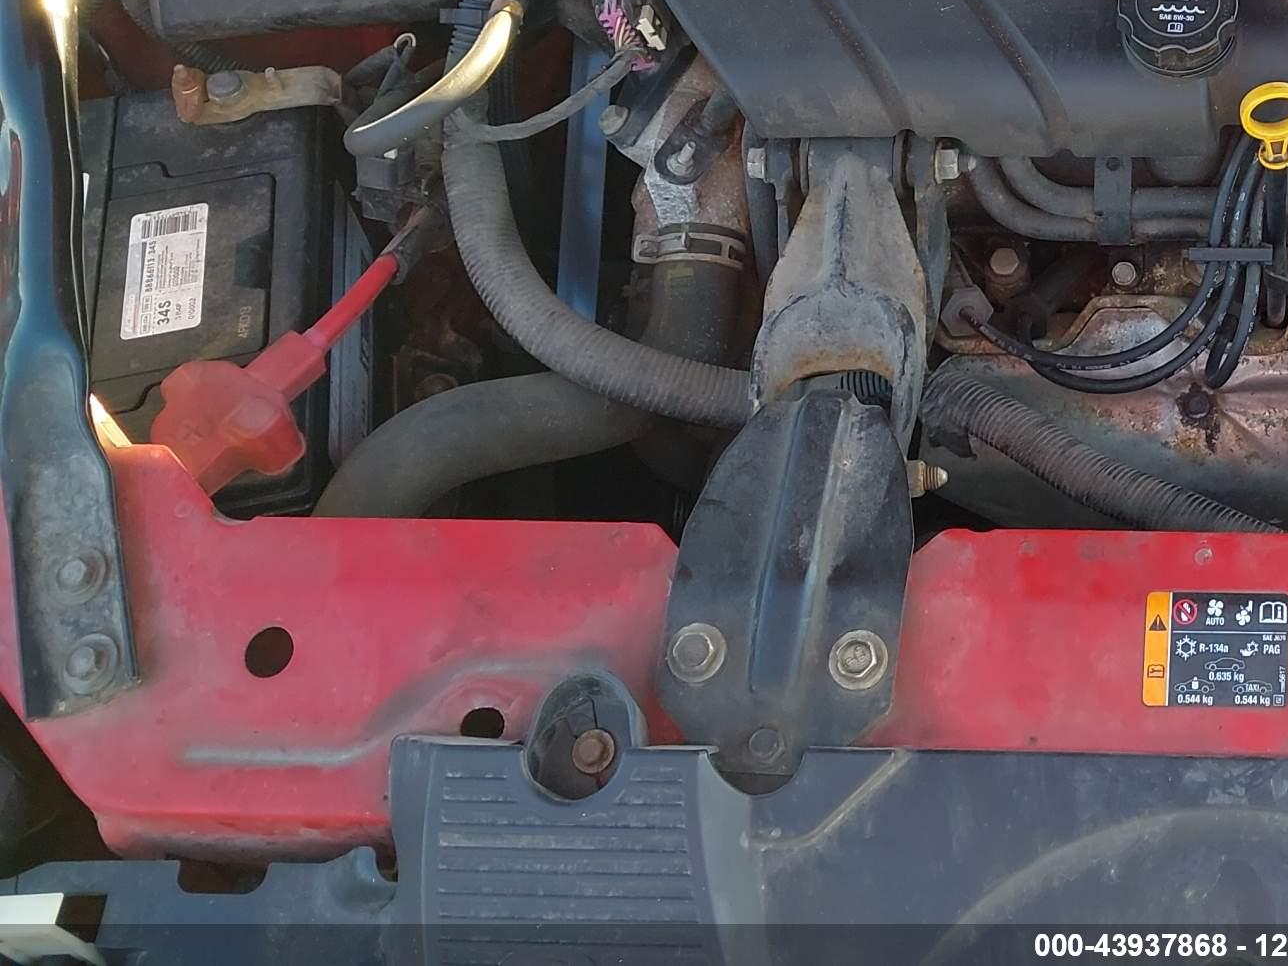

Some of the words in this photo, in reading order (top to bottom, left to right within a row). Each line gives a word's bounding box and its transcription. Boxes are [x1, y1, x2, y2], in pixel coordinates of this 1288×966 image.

[157, 300, 171, 325] 34S
[1200, 644, 1229, 653] R-134a
[1263, 645, 1280, 654] PAG
[1209, 672, 1232, 681] 0.635
[1234, 672, 1244, 682] kg
[1246, 684, 1259, 692] TAXI
[1178, 695, 1200, 704] 0.544
[1202, 695, 1213, 705] kg
[1235, 695, 1258, 704] 0.544
[1260, 695, 1270, 706] kg
